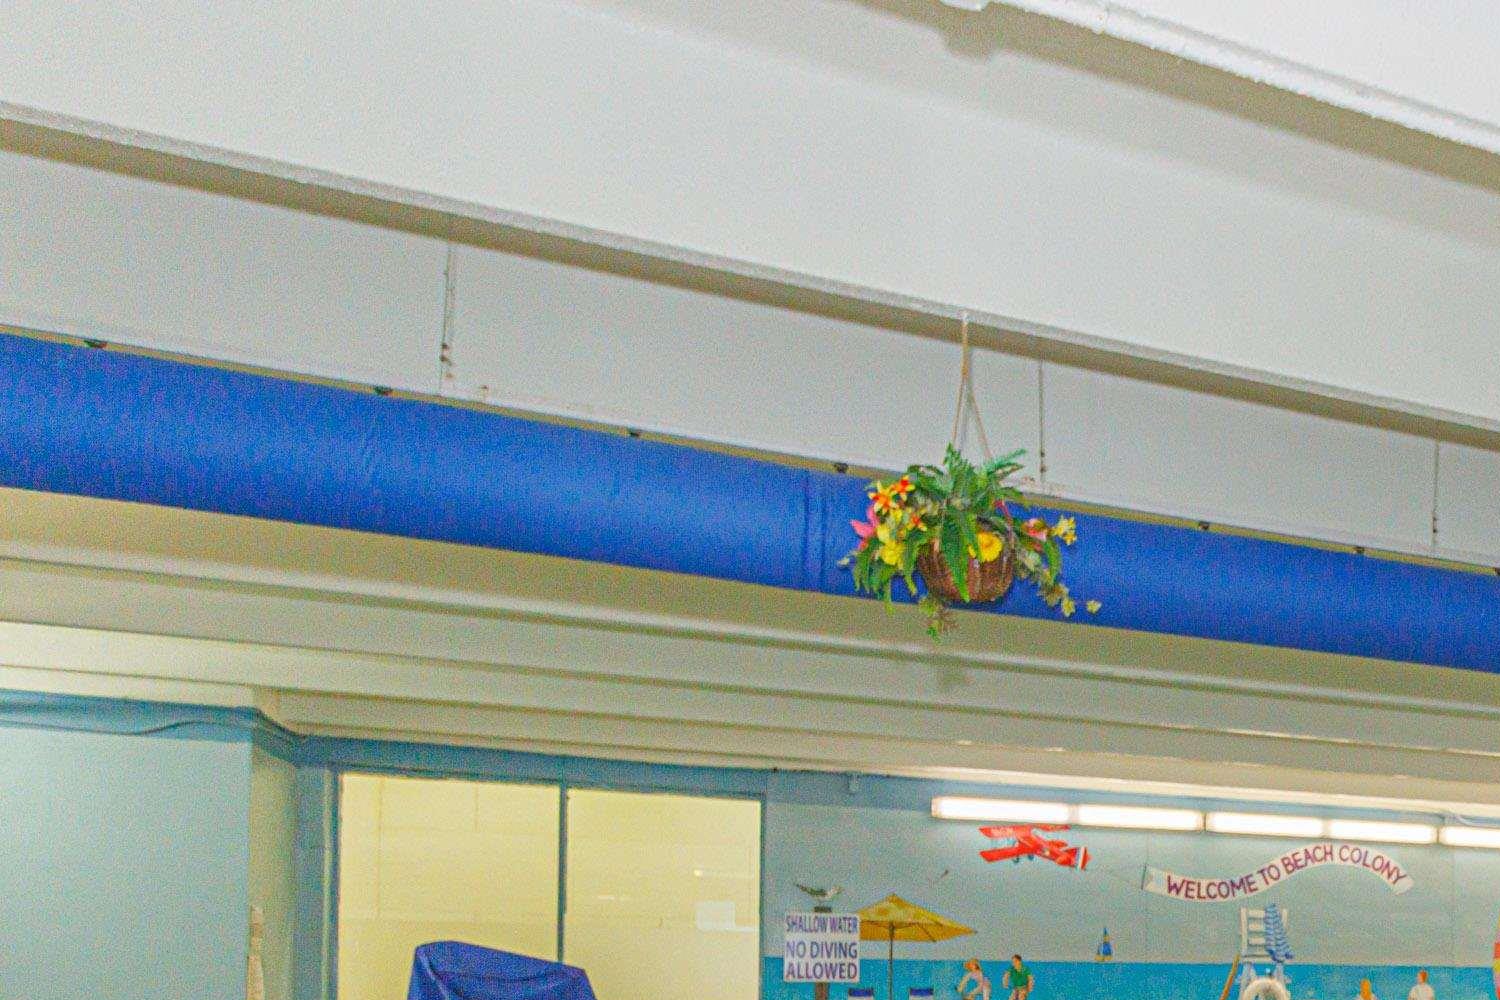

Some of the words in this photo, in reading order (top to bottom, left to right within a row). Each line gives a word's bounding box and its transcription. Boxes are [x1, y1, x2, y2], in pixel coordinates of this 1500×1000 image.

[1167, 874, 1259, 899] WELCOME
[1257, 864, 1281, 886] TO
[1281, 844, 1334, 874] BEACH
[1338, 844, 1407, 885] COLONY
[786, 915, 827, 933] SHALLOW
[829, 915, 858, 933] WATER
[786, 941, 806, 958] NO
[810, 941, 858, 959] DIVING
[785, 961, 858, 979] ALLOWED
